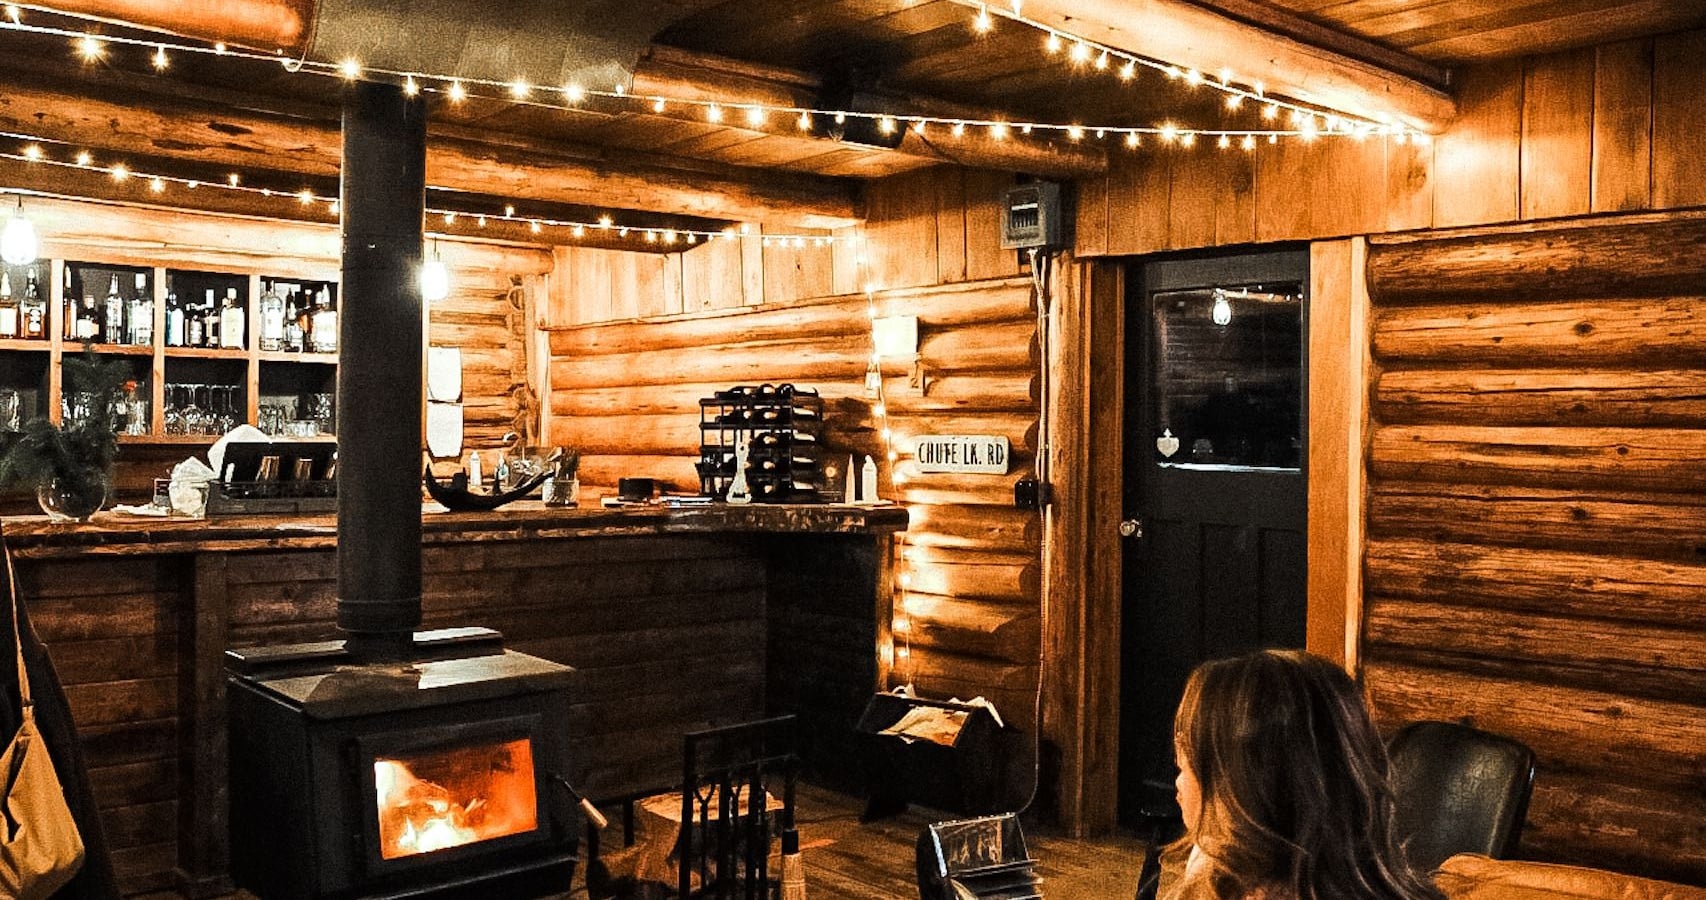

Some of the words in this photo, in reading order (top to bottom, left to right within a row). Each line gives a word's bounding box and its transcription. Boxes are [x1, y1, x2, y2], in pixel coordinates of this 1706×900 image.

[918, 442, 958, 465] CHUTE
[963, 443, 982, 465] LK.
[987, 443, 1005, 465] RD
